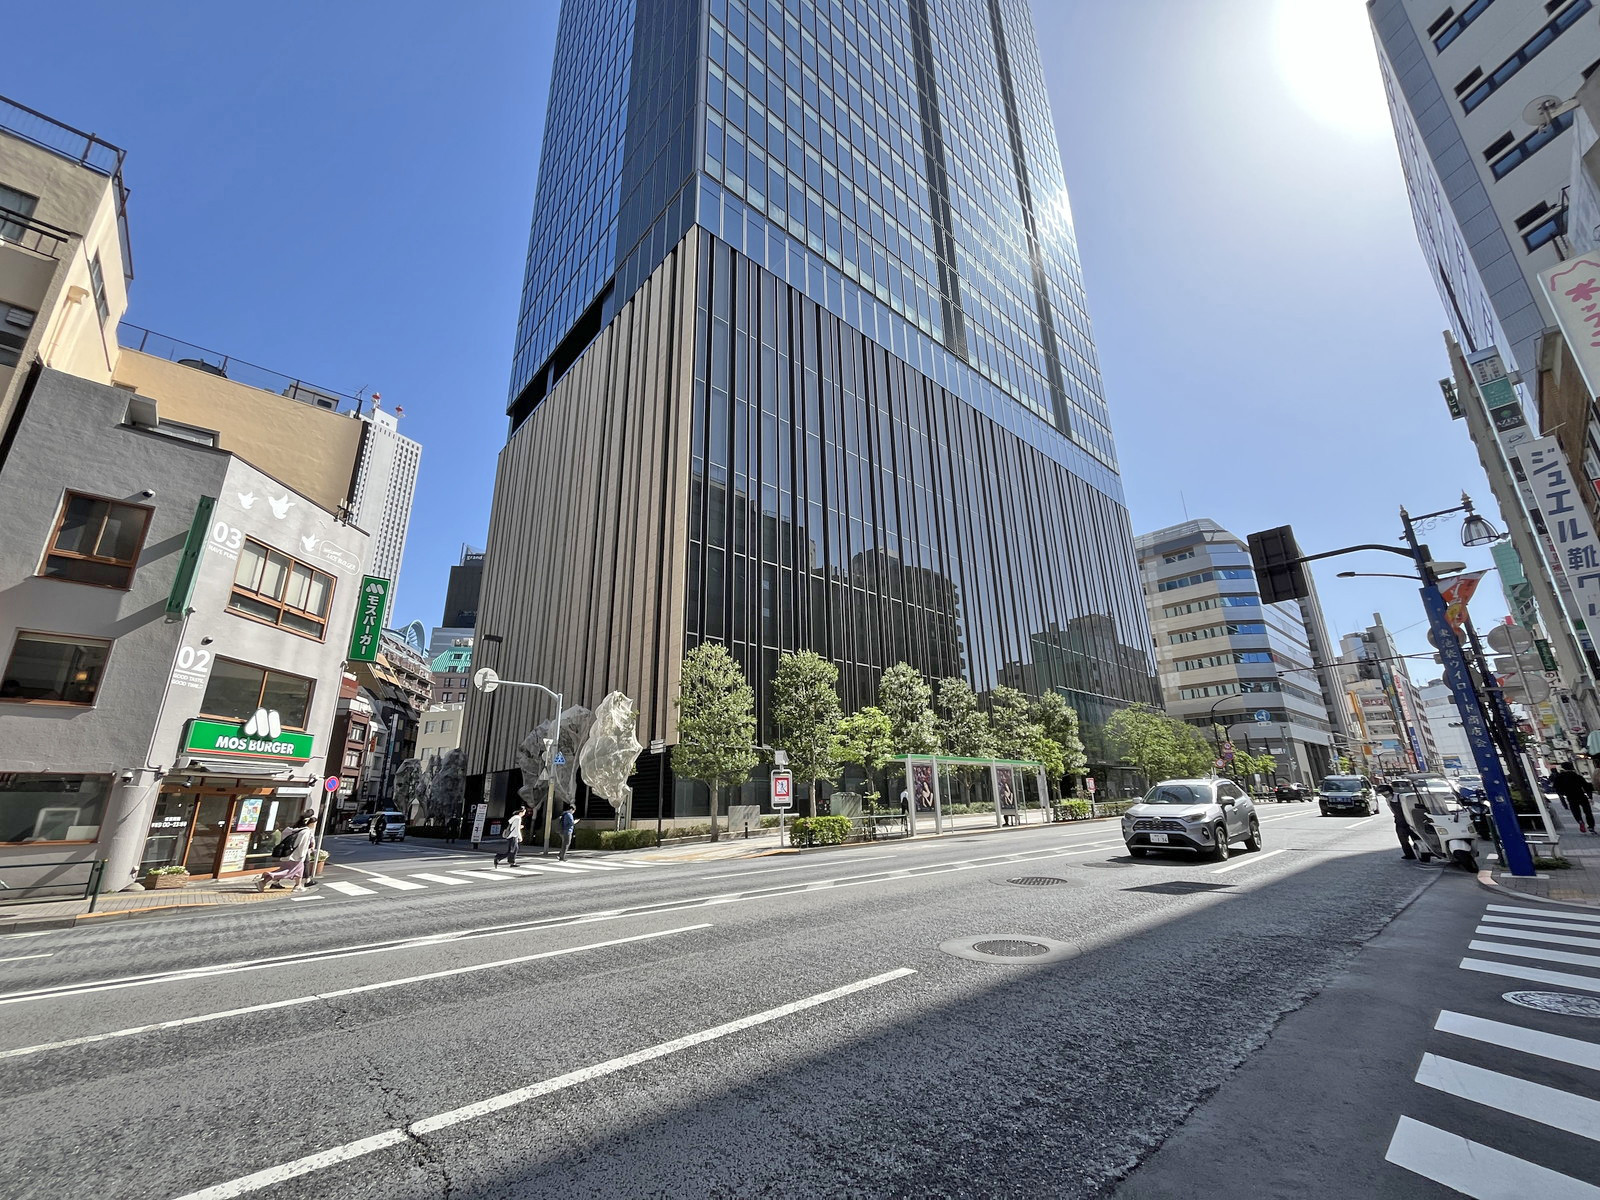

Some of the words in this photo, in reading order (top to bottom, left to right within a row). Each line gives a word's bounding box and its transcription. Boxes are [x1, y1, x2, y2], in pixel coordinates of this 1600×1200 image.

[213, 522, 241, 549] 03
[1532, 447, 1600, 617] ジュエル靴
[359, 595, 379, 654] モスバーガー
[179, 646, 210, 672] 02
[216, 736, 247, 749] MOS
[248, 741, 294, 754] BURGER
